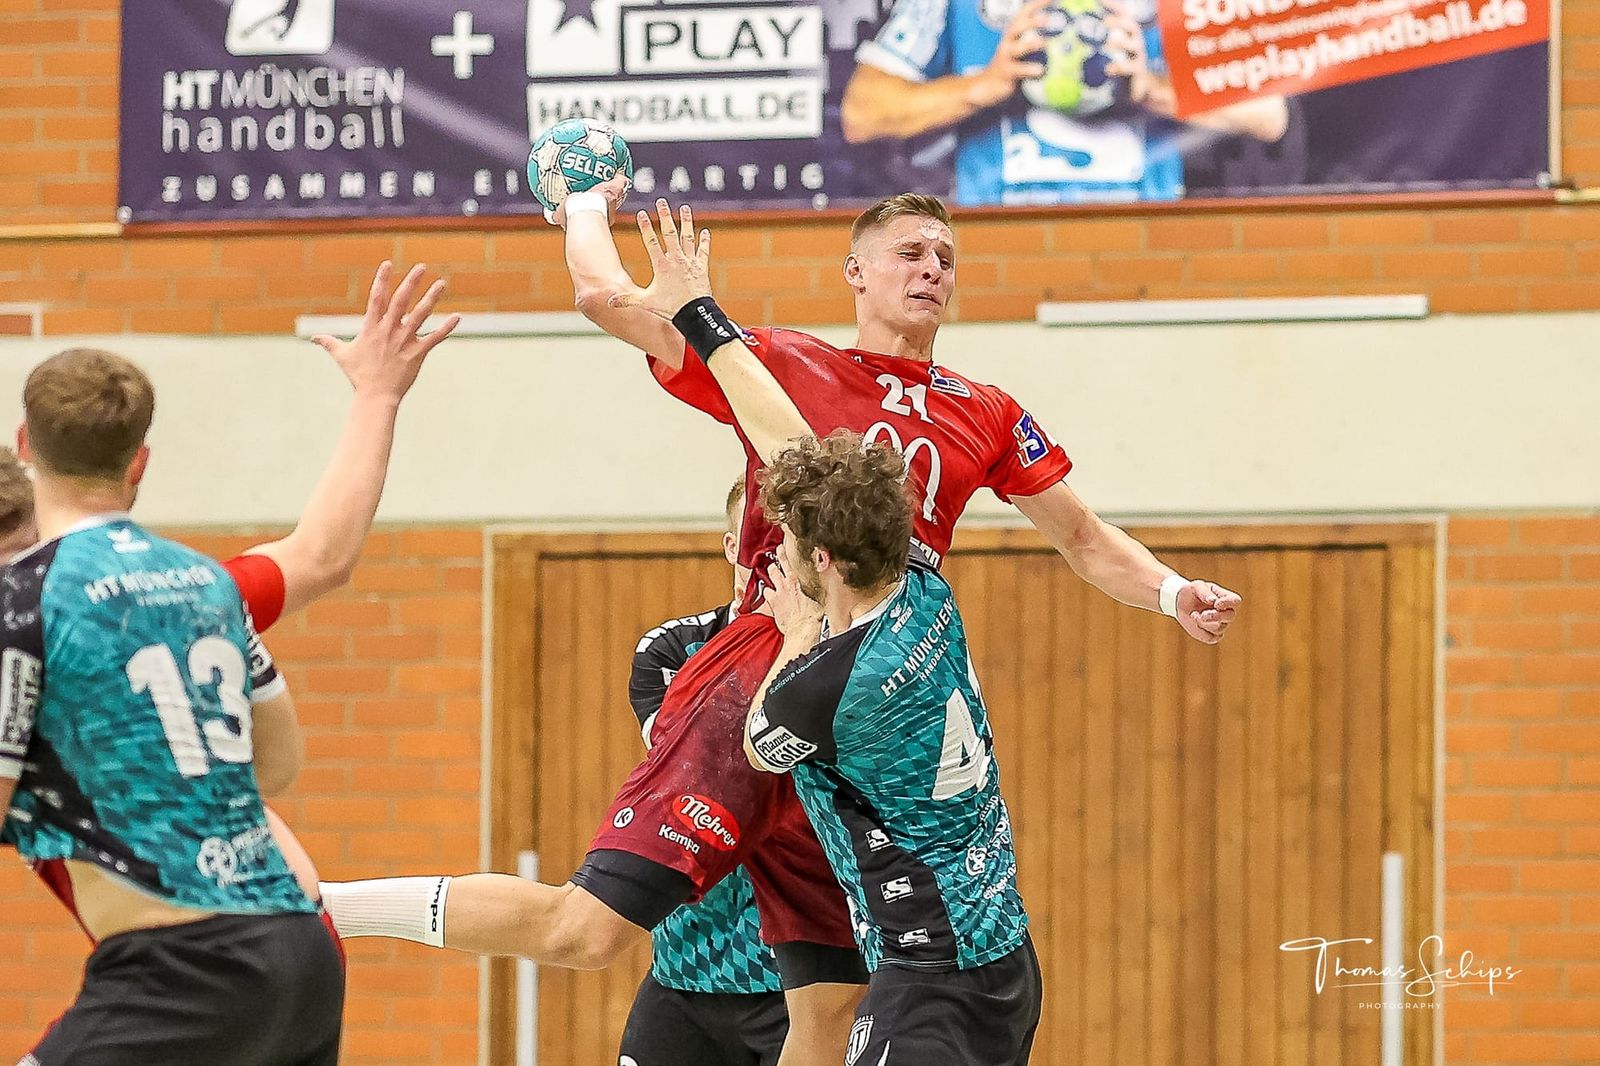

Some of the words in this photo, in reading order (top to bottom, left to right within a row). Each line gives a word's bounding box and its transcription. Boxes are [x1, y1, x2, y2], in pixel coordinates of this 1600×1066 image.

[646, 18, 803, 61] PLAY
[1193, 0, 1528, 95] weplayhandball.de
[162, 69, 220, 110] HT
[220, 63, 405, 109] MÜNCHEN
[161, 105, 405, 153] handball
[161, 169, 436, 203] ZUSAMMEN
[562, 151, 616, 181] SELEC
[875, 373, 934, 424] 21
[880, 667, 906, 697] HT
[903, 597, 954, 675] MÜNCHEN
[126, 636, 254, 779] 13
[658, 824, 700, 854] Kempa
